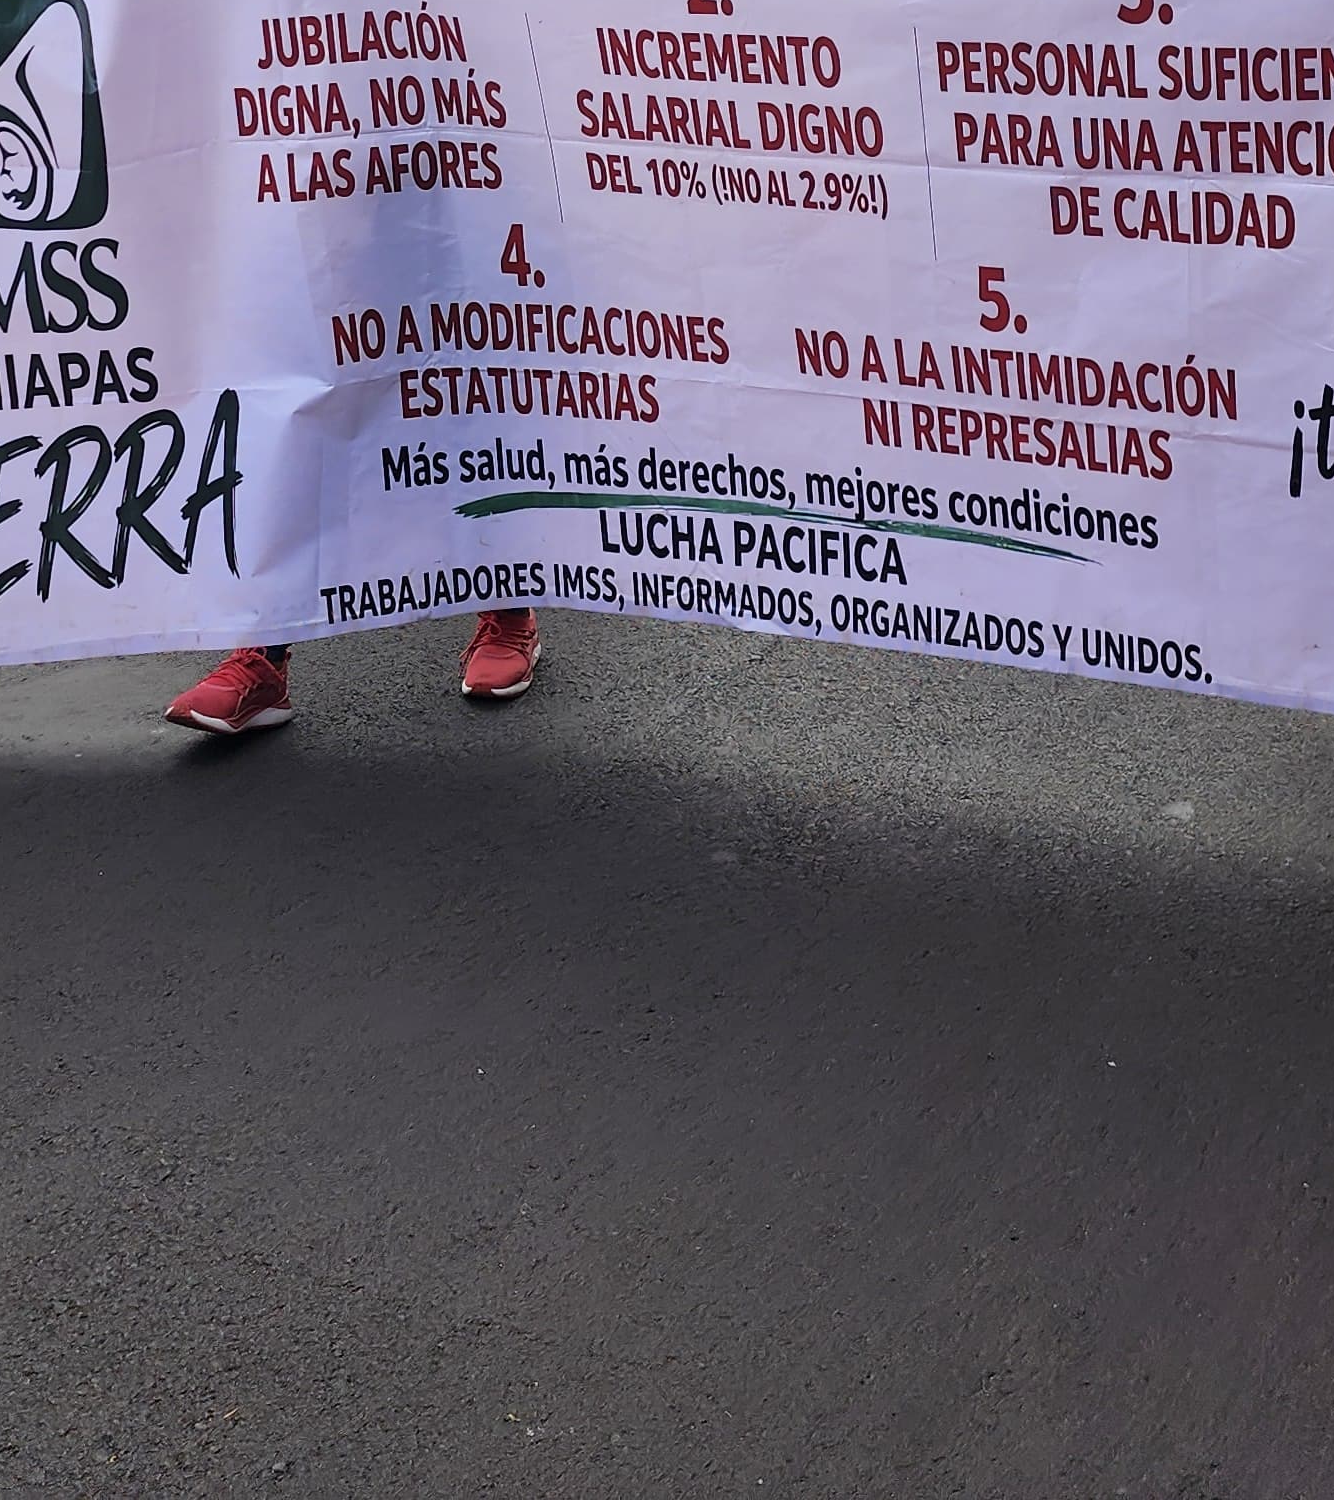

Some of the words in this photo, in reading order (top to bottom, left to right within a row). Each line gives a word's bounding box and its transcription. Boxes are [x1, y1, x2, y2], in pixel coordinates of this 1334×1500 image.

[257, 0, 467, 70] JUBILACIÓN
[596, 27, 841, 88] INCREMENTO
[234, 82, 361, 139] DIGNA,
[369, 75, 426, 128] NO
[431, 68, 507, 128] MÁS
[936, 41, 1148, 98] PERSONAL
[576, 89, 751, 149] SALARIAL
[758, 101, 884, 157] DIGNO
[954, 112, 1063, 168] PARA
[1072, 116, 1163, 172] UNA
[257, 153, 281, 203] A
[286, 149, 356, 203] LAS
[366, 140, 503, 195] AFORES
[586, 152, 642, 194] DEL
[646, 158, 707, 200] 10%
[712, 163, 761, 206] (!NO
[767, 170, 796, 207] AL
[799, 170, 888, 220] 2.9%!)
[1049, 185, 1104, 237] DE
[1113, 187, 1296, 250] CALIDAD
[500, 223, 546, 288] 4.
[331, 308, 387, 366] NO
[396, 305, 423, 354] A
[430, 301, 730, 365] MODIFICACIONES
[977, 265, 1028, 334] 5.
[399, 367, 660, 424] ESTATUTARIAS
[794, 327, 850, 379] NO
[861, 334, 889, 383] A
[894, 338, 945, 390] LA
[951, 345, 1237, 420] INTIMIDACIÓN
[863, 398, 901, 448] NI
[912, 403, 1173, 481] REPRESALIAS
[381, 441, 450, 491] Más
[459, 436, 556, 491] salud,
[564, 443, 629, 490] más
[637, 447, 796, 508] derechos,
[805, 468, 939, 521] mejores
[948, 488, 1159, 550] condiciones
[599, 509, 723, 565] LUCHA
[733, 520, 908, 586] PACIFICA
[320, 562, 546, 625] TRABAJADORES
[553, 563, 625, 612] IMSS,
[632, 571, 822, 637] INFORMADOS,
[830, 594, 1045, 659] ORGANIZADOS
[1052, 623, 1072, 662] Y
[1081, 628, 1213, 685] UNIDOS.
